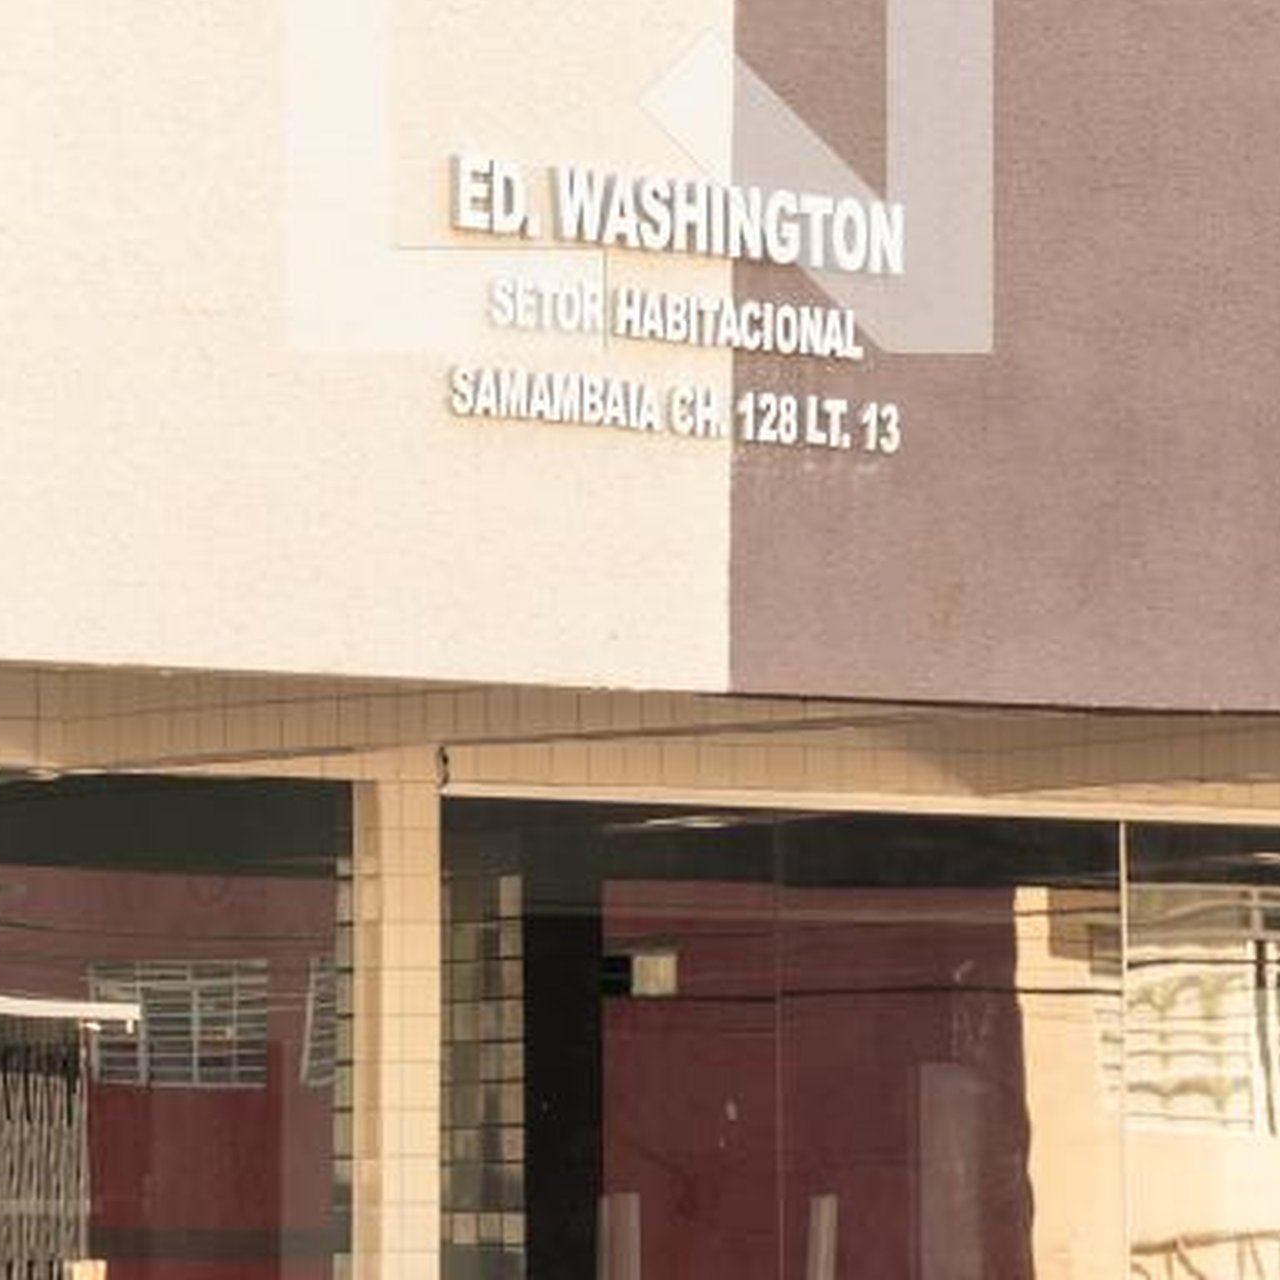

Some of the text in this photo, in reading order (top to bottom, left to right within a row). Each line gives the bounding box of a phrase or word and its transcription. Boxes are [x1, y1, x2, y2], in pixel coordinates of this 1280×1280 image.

[456, 157, 905, 274] ED. WASHINGTON
[489, 274, 863, 359] SETOR HABITACIONAL
[451, 366, 901, 453] SAMAMBAIA CH. 128 LT. 13
